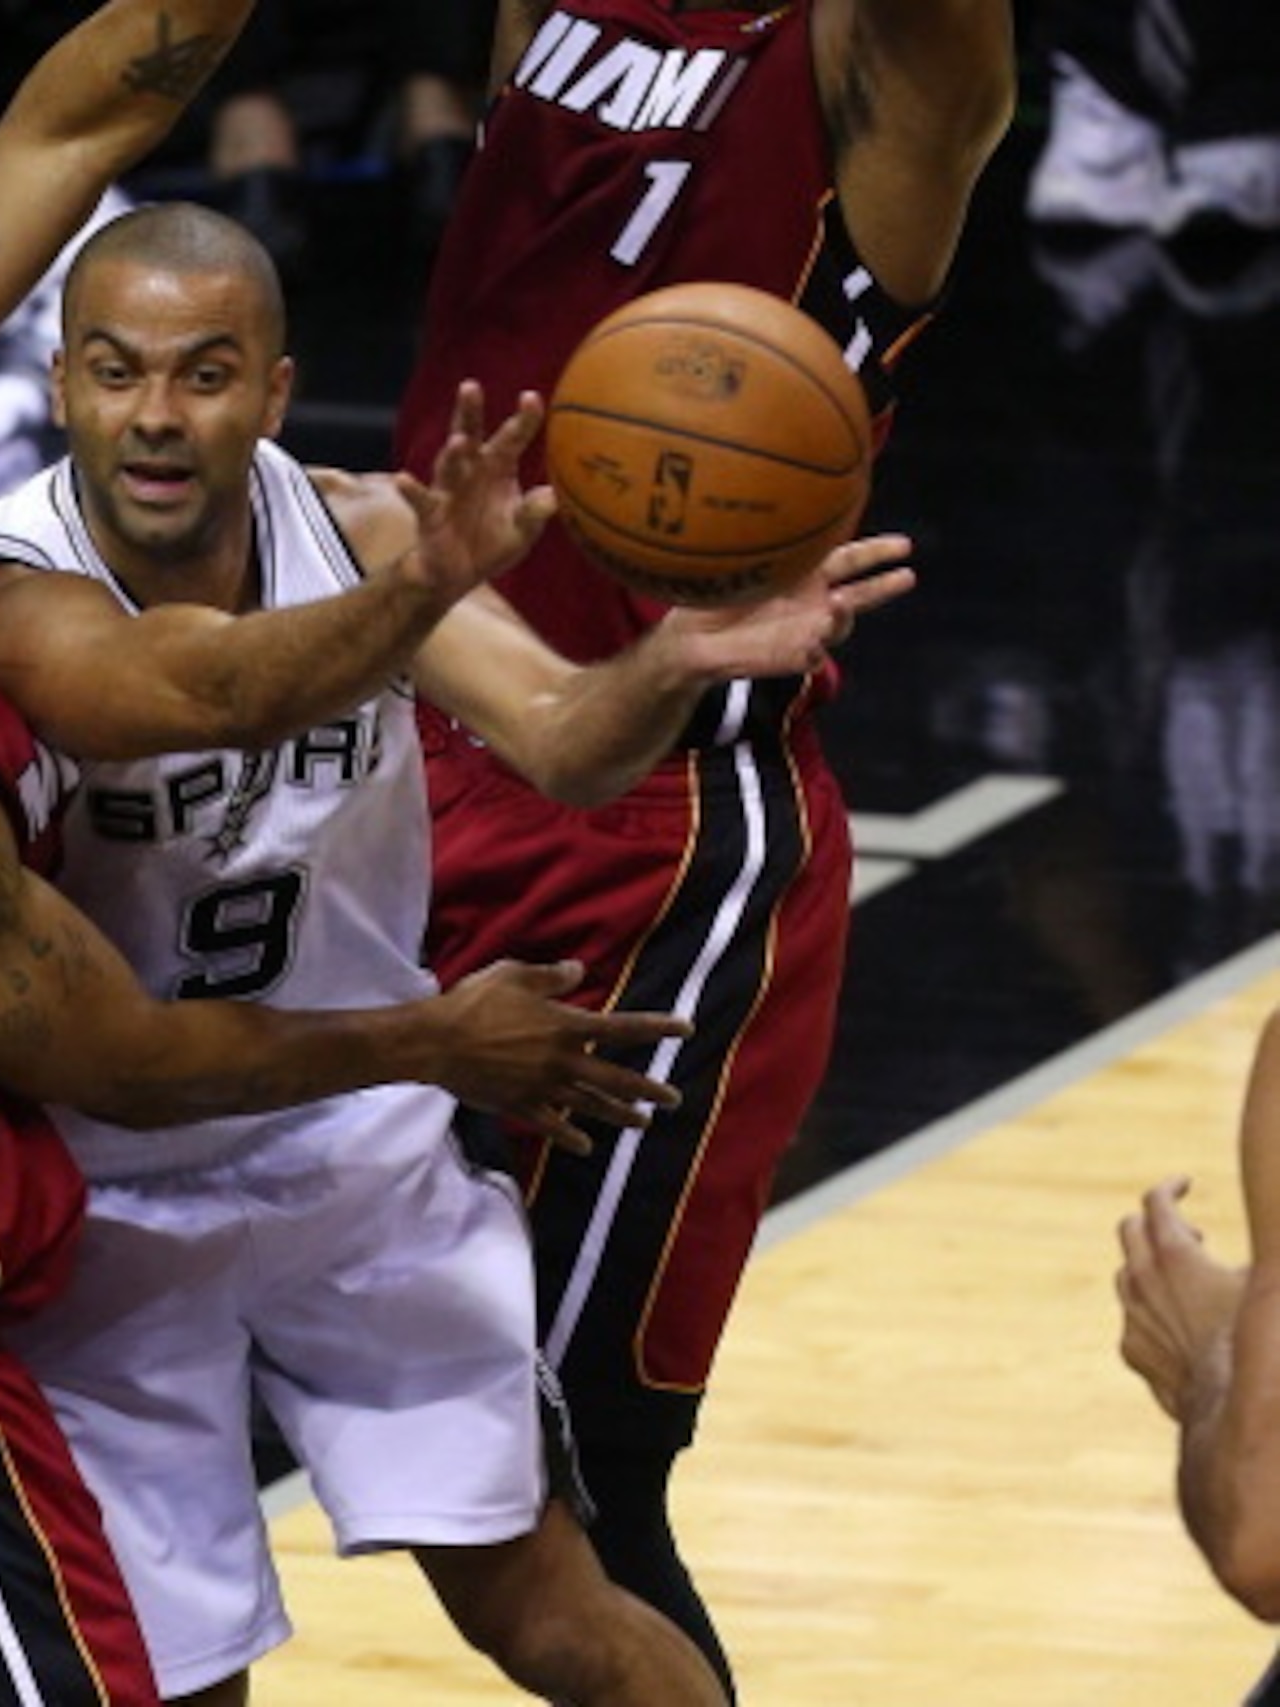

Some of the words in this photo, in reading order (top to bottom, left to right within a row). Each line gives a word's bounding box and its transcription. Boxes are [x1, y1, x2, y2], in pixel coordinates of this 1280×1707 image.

[609, 160, 692, 266] 1
[85, 704, 382, 852] SPUR
[176, 866, 309, 1000] 9
